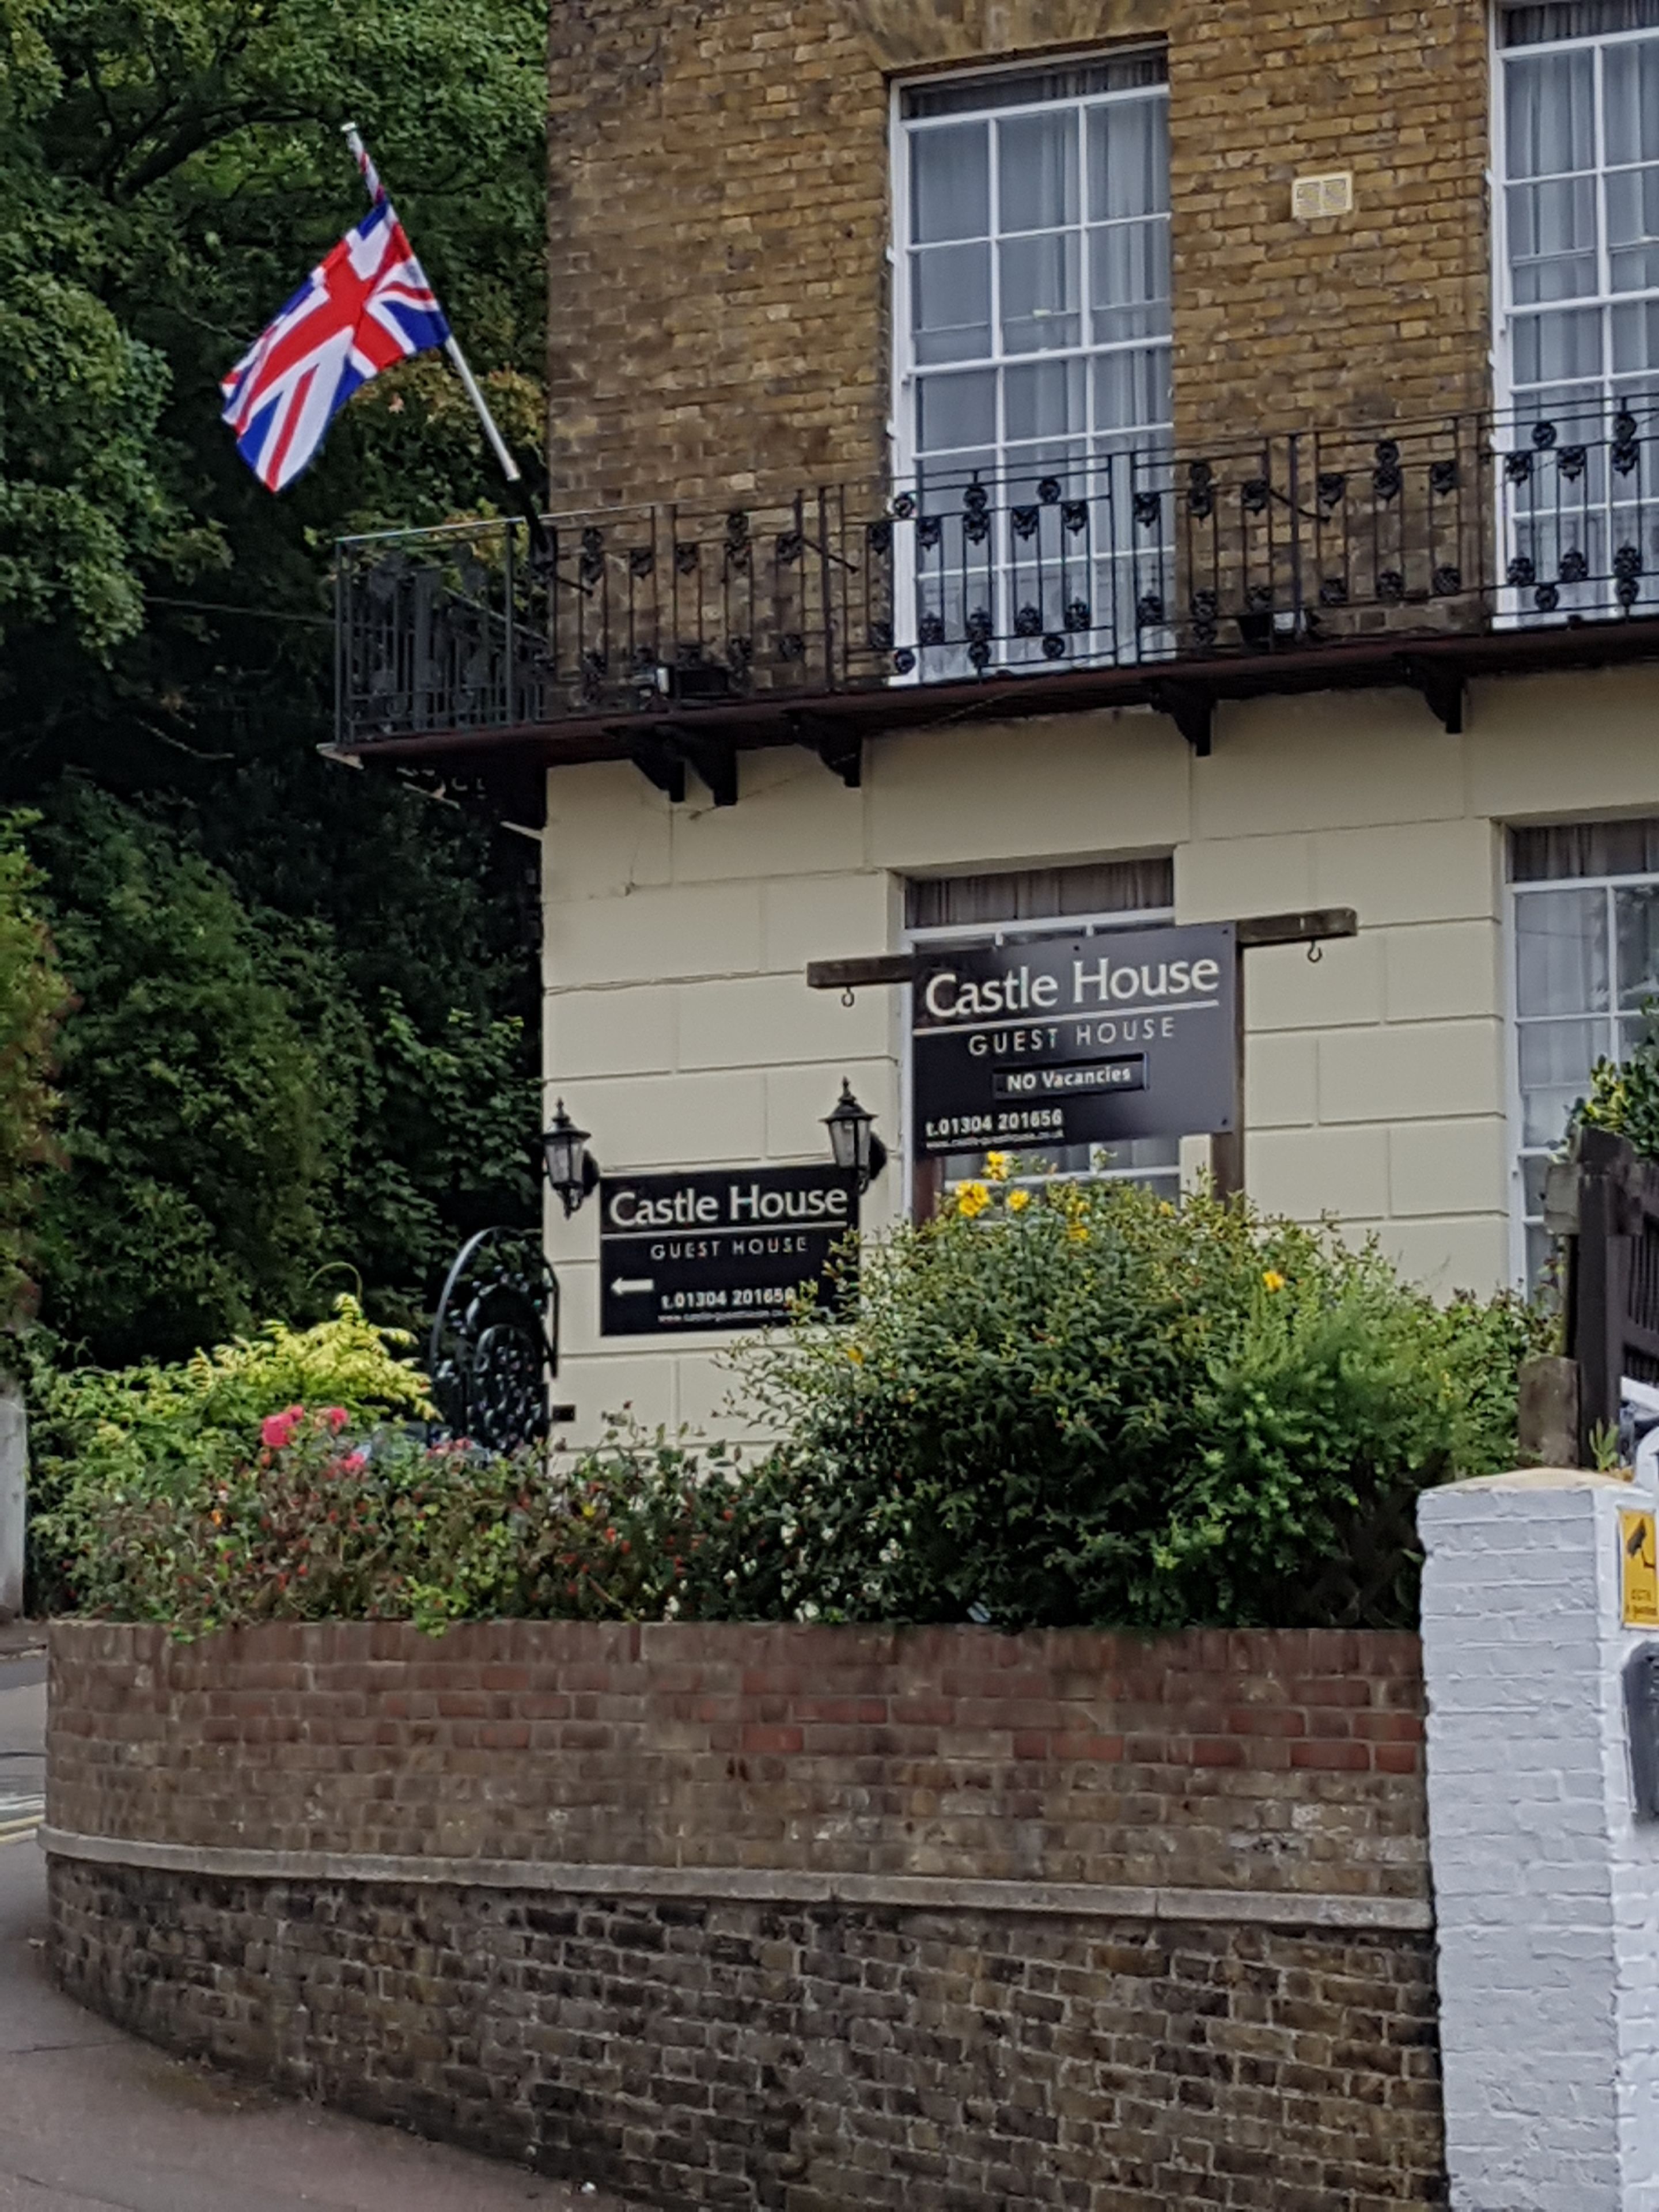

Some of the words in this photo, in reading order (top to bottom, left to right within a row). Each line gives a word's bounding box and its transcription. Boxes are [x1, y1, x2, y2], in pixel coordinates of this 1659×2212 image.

[925, 965, 1058, 1018] Castle
[1073, 957, 1220, 1004] House
[968, 1028, 1058, 1056] GUEST
[1076, 1016, 1176, 1047] HOUSE
[1007, 1073, 1036, 1092] NO
[1041, 1066, 1131, 1089] Vacancies
[609, 1187, 719, 1226] Castle
[729, 1184, 849, 1221] House
[650, 1240, 722, 1261] GUEST
[732, 1236, 807, 1255] HOUSE
